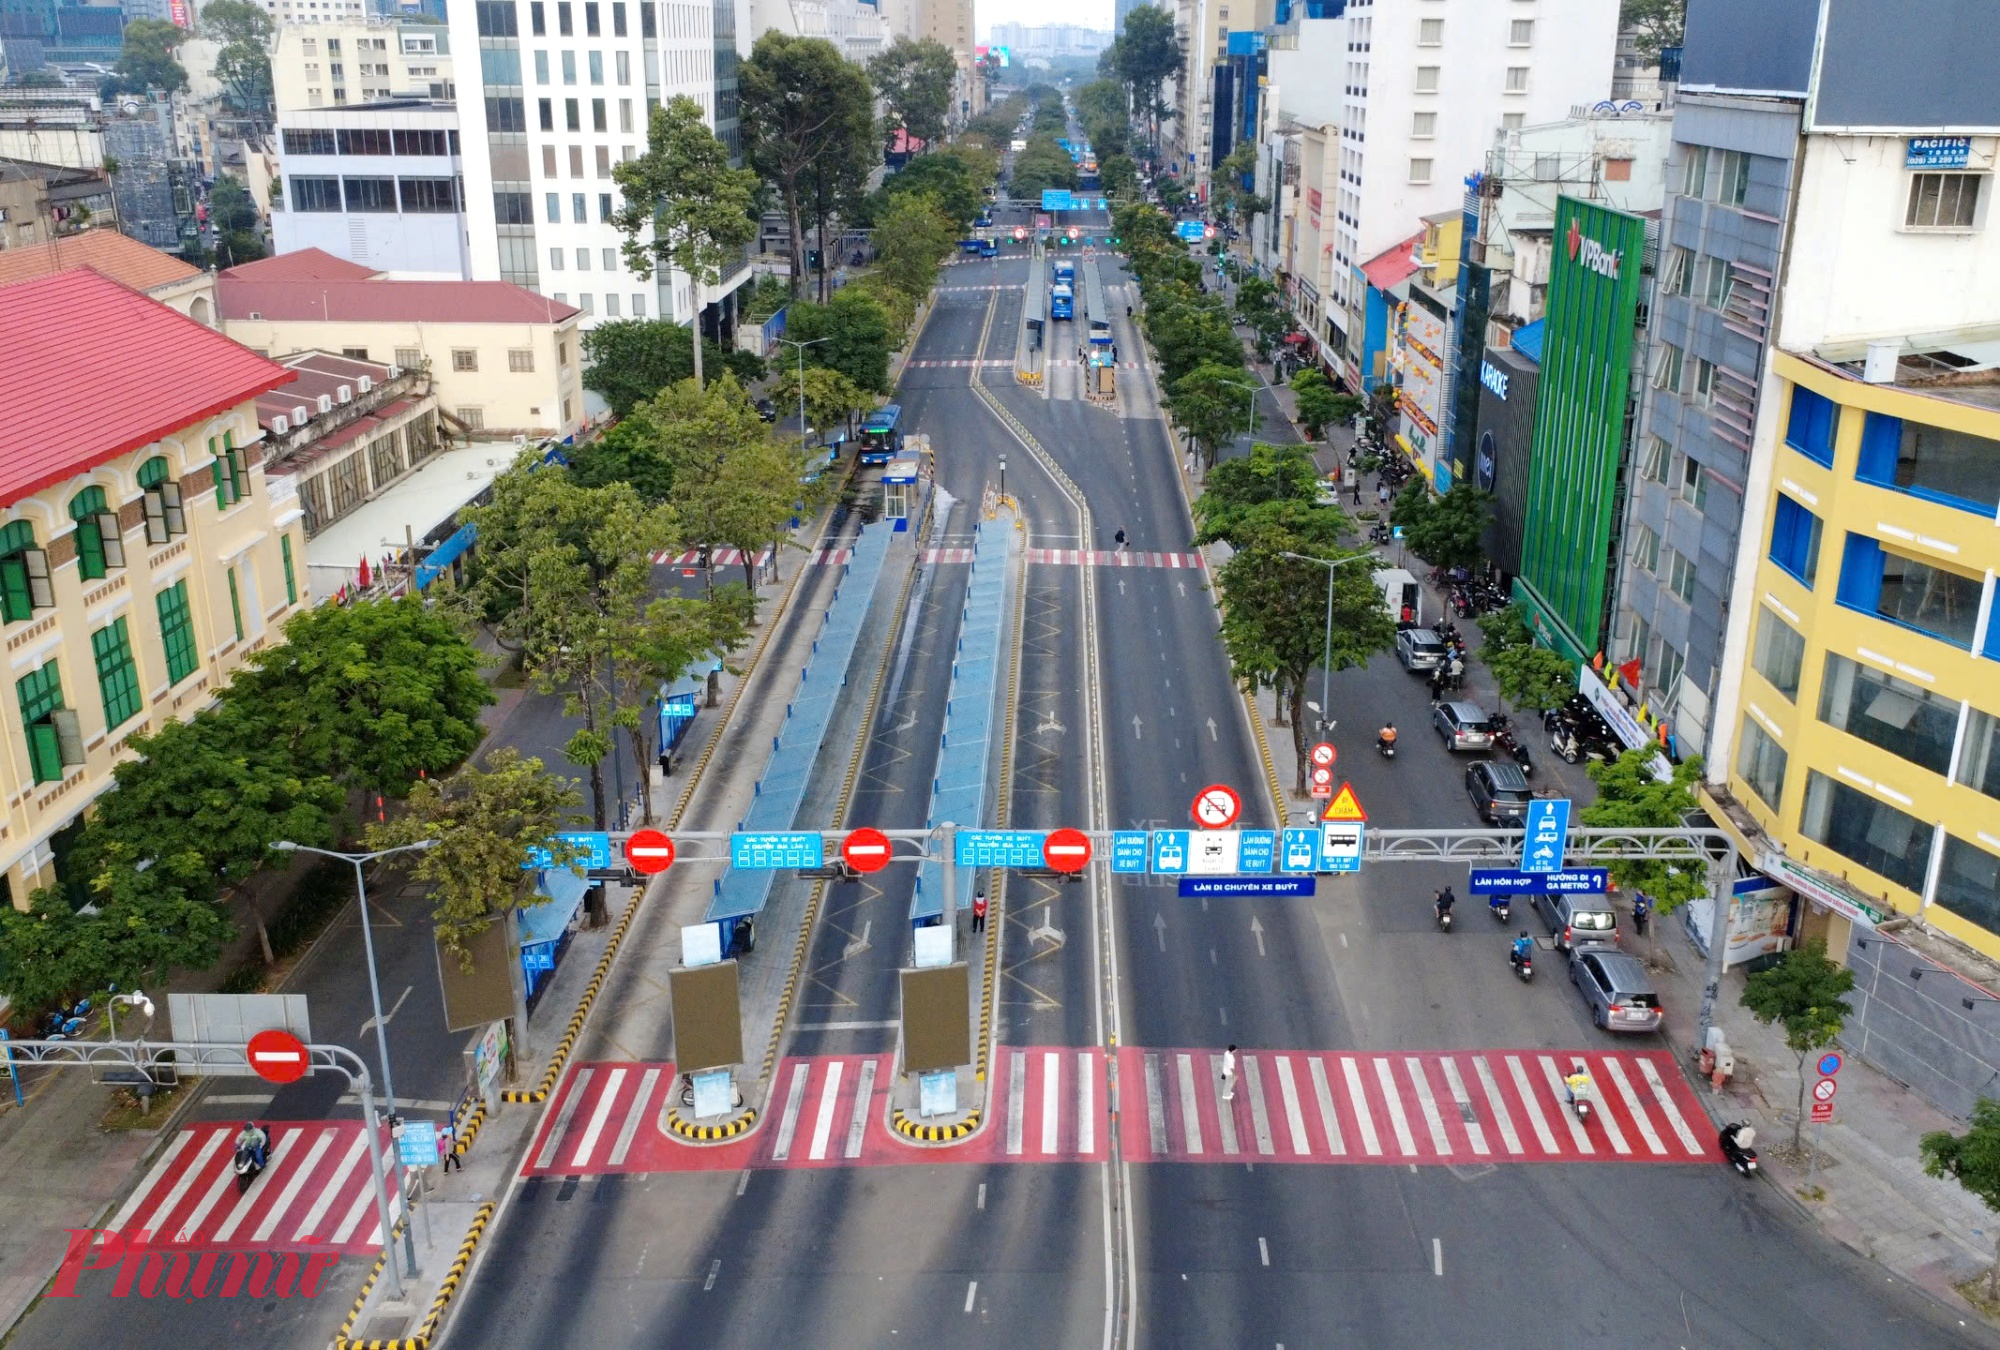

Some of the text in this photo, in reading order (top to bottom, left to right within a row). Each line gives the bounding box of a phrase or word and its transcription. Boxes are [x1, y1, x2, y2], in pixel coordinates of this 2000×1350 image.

[1914, 139, 1965, 148] PACIFIC
[1579, 235, 1623, 280] VPBank
[1481, 360, 1508, 400] KARAOKE
[1132, 848, 1142, 856] CHO
[1244, 847, 1269, 856] DÀNH CHO
[1127, 859, 1139, 867] BUÝT
[1253, 859, 1265, 868] BUÝT
[1547, 873, 1577, 881] HƯỚNG
[1513, 878, 1532, 886] HỢP
[1194, 883, 1211, 891] LÀN
